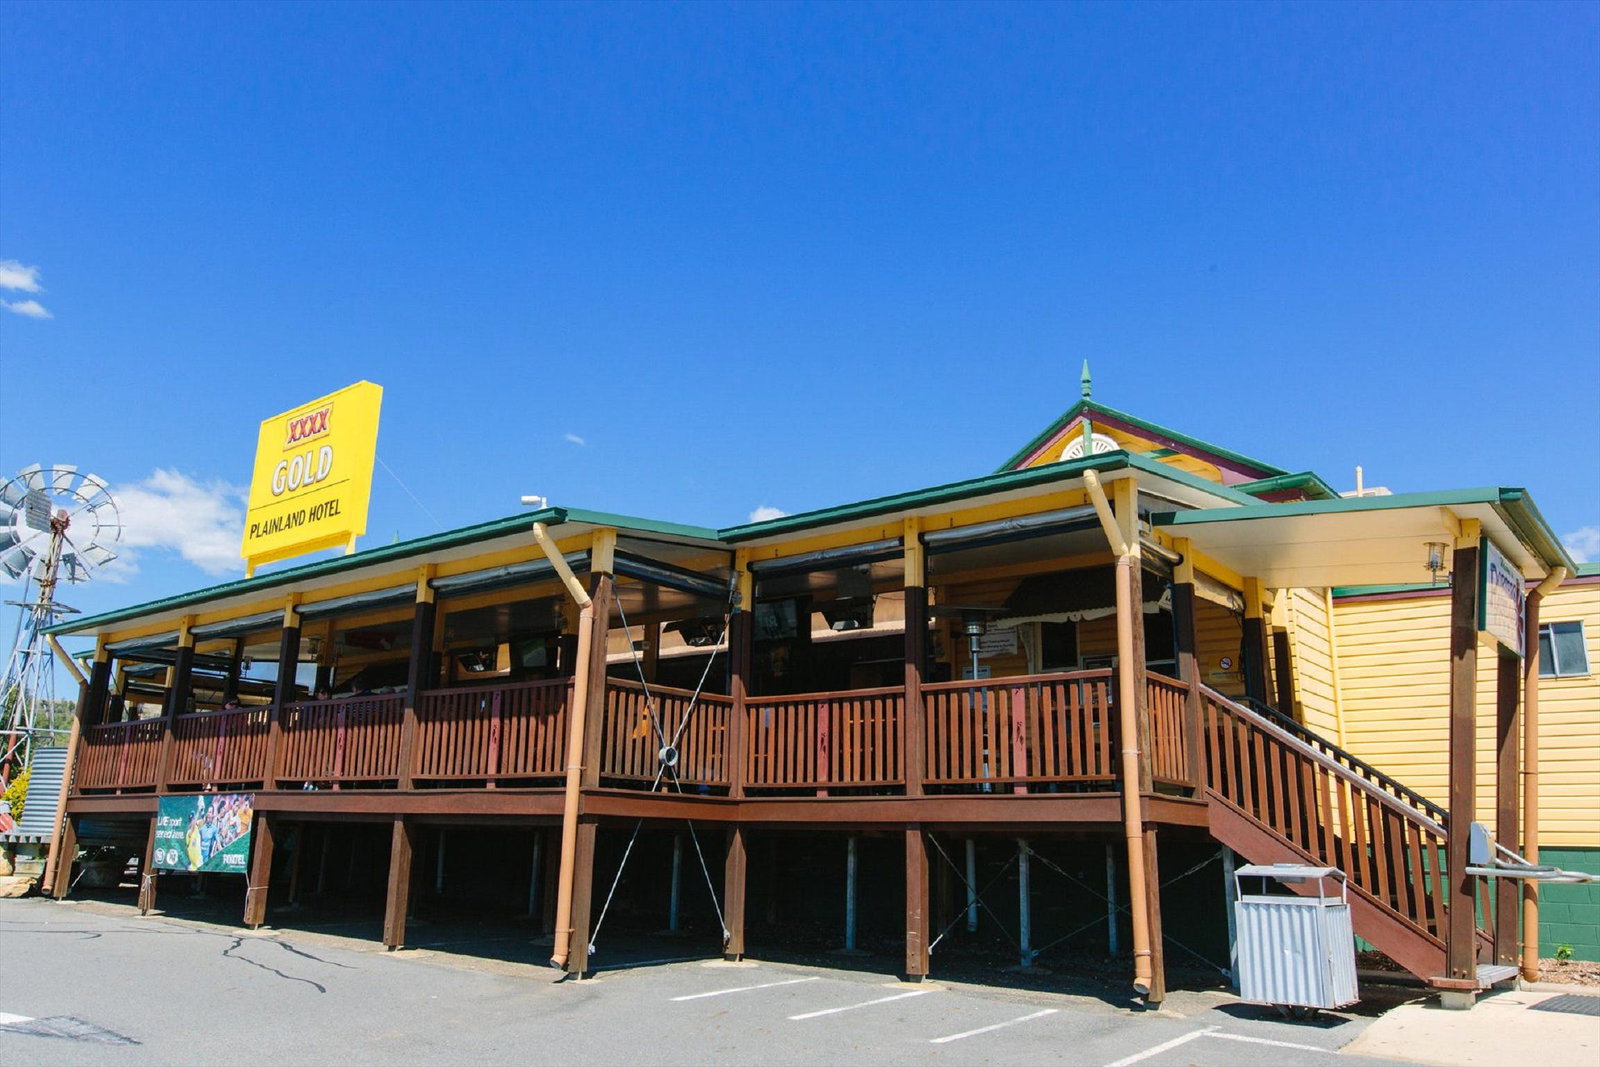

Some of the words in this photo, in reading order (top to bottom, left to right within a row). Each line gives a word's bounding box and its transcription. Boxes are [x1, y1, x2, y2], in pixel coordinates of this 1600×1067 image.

[287, 408, 330, 443] XXXX
[271, 446, 333, 496] GOLD
[250, 509, 306, 540] PLAINLAND
[308, 498, 341, 523] HOTEL
